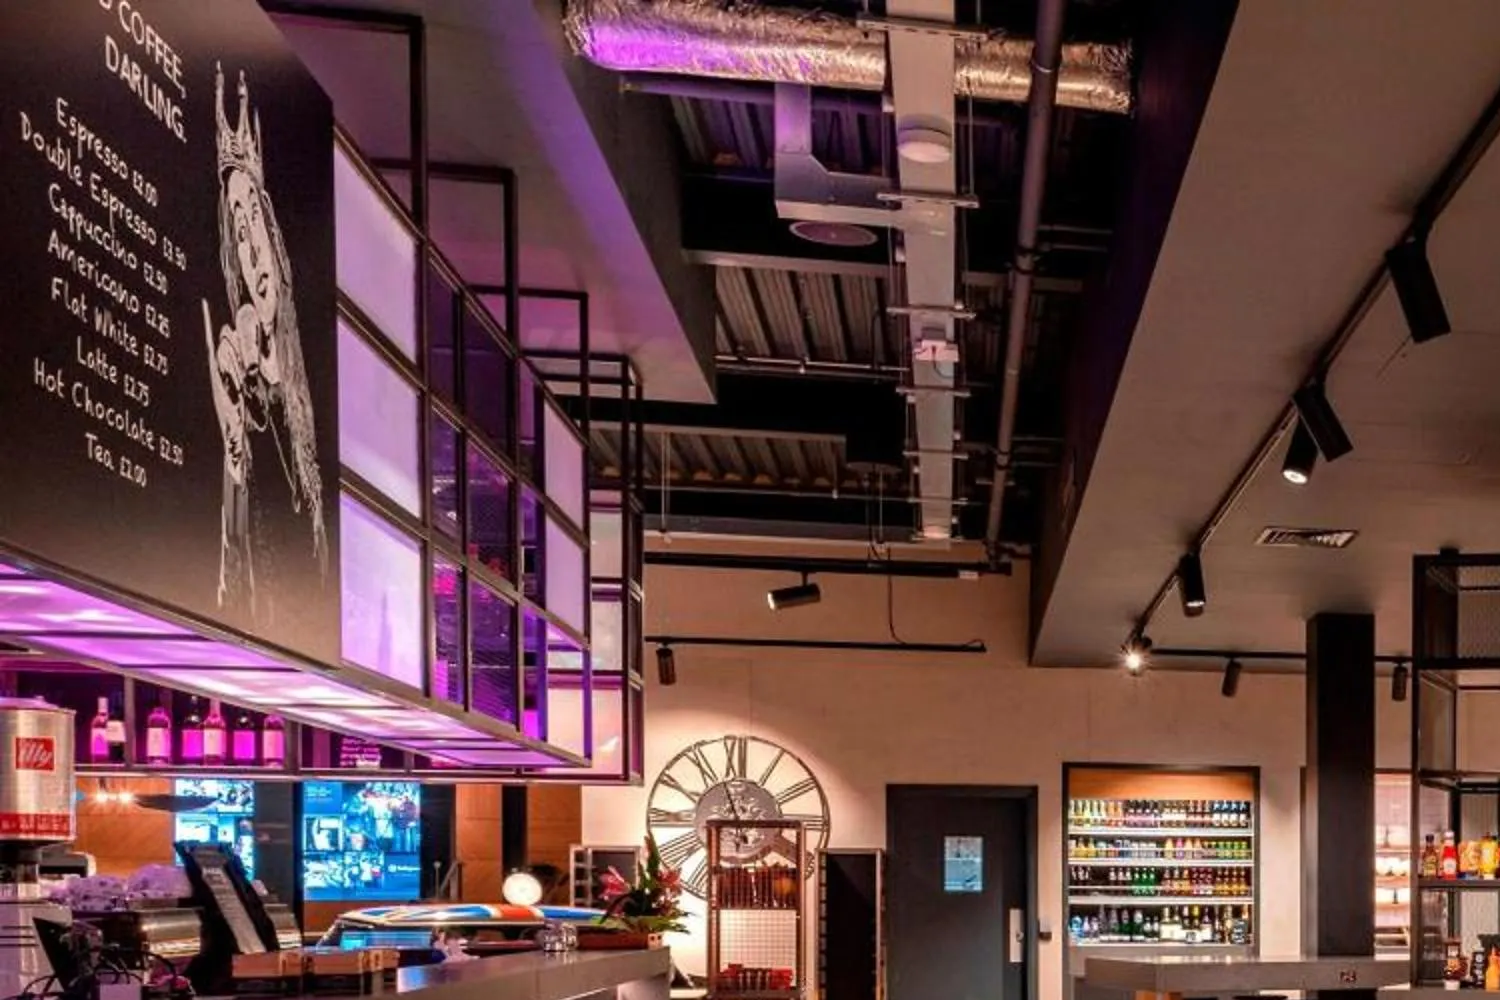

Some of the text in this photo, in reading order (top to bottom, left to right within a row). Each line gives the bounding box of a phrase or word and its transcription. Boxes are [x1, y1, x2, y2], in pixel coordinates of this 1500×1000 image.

[118, 0, 187, 99] COFFEE,
[20, 111, 83, 187] Double
[89, 172, 157, 247] Espresso
[56, 97, 129, 180] Espresso
[48, 183, 138, 270] Cappuccino
[48, 229, 140, 314] Americano
[51, 276, 88, 323] Flat
[94, 306, 139, 357] White
[76, 335, 118, 385] Latte
[33, 356, 65, 398] Hot
[71, 381, 155, 451] Chocolate
[85, 431, 115, 470] Tea
[18, 740, 53, 768] illy
